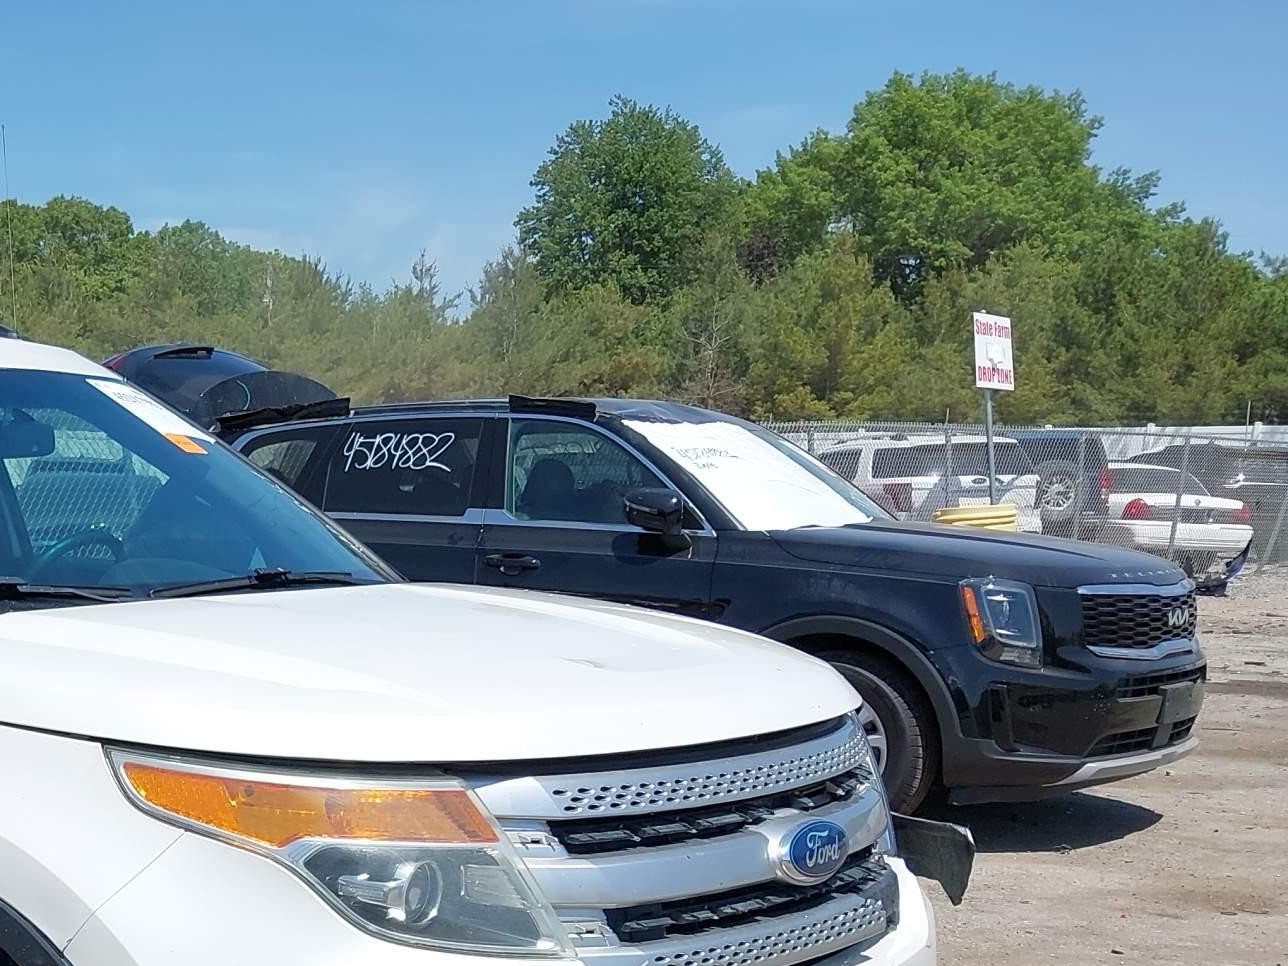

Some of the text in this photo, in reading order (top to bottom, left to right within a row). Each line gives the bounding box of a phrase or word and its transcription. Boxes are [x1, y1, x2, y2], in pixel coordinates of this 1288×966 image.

[975, 319, 1011, 340] State Farm
[978, 365, 1013, 385] DROP ZONE
[343, 431, 455, 473] 45184882
[806, 830, 841, 868] Ford
